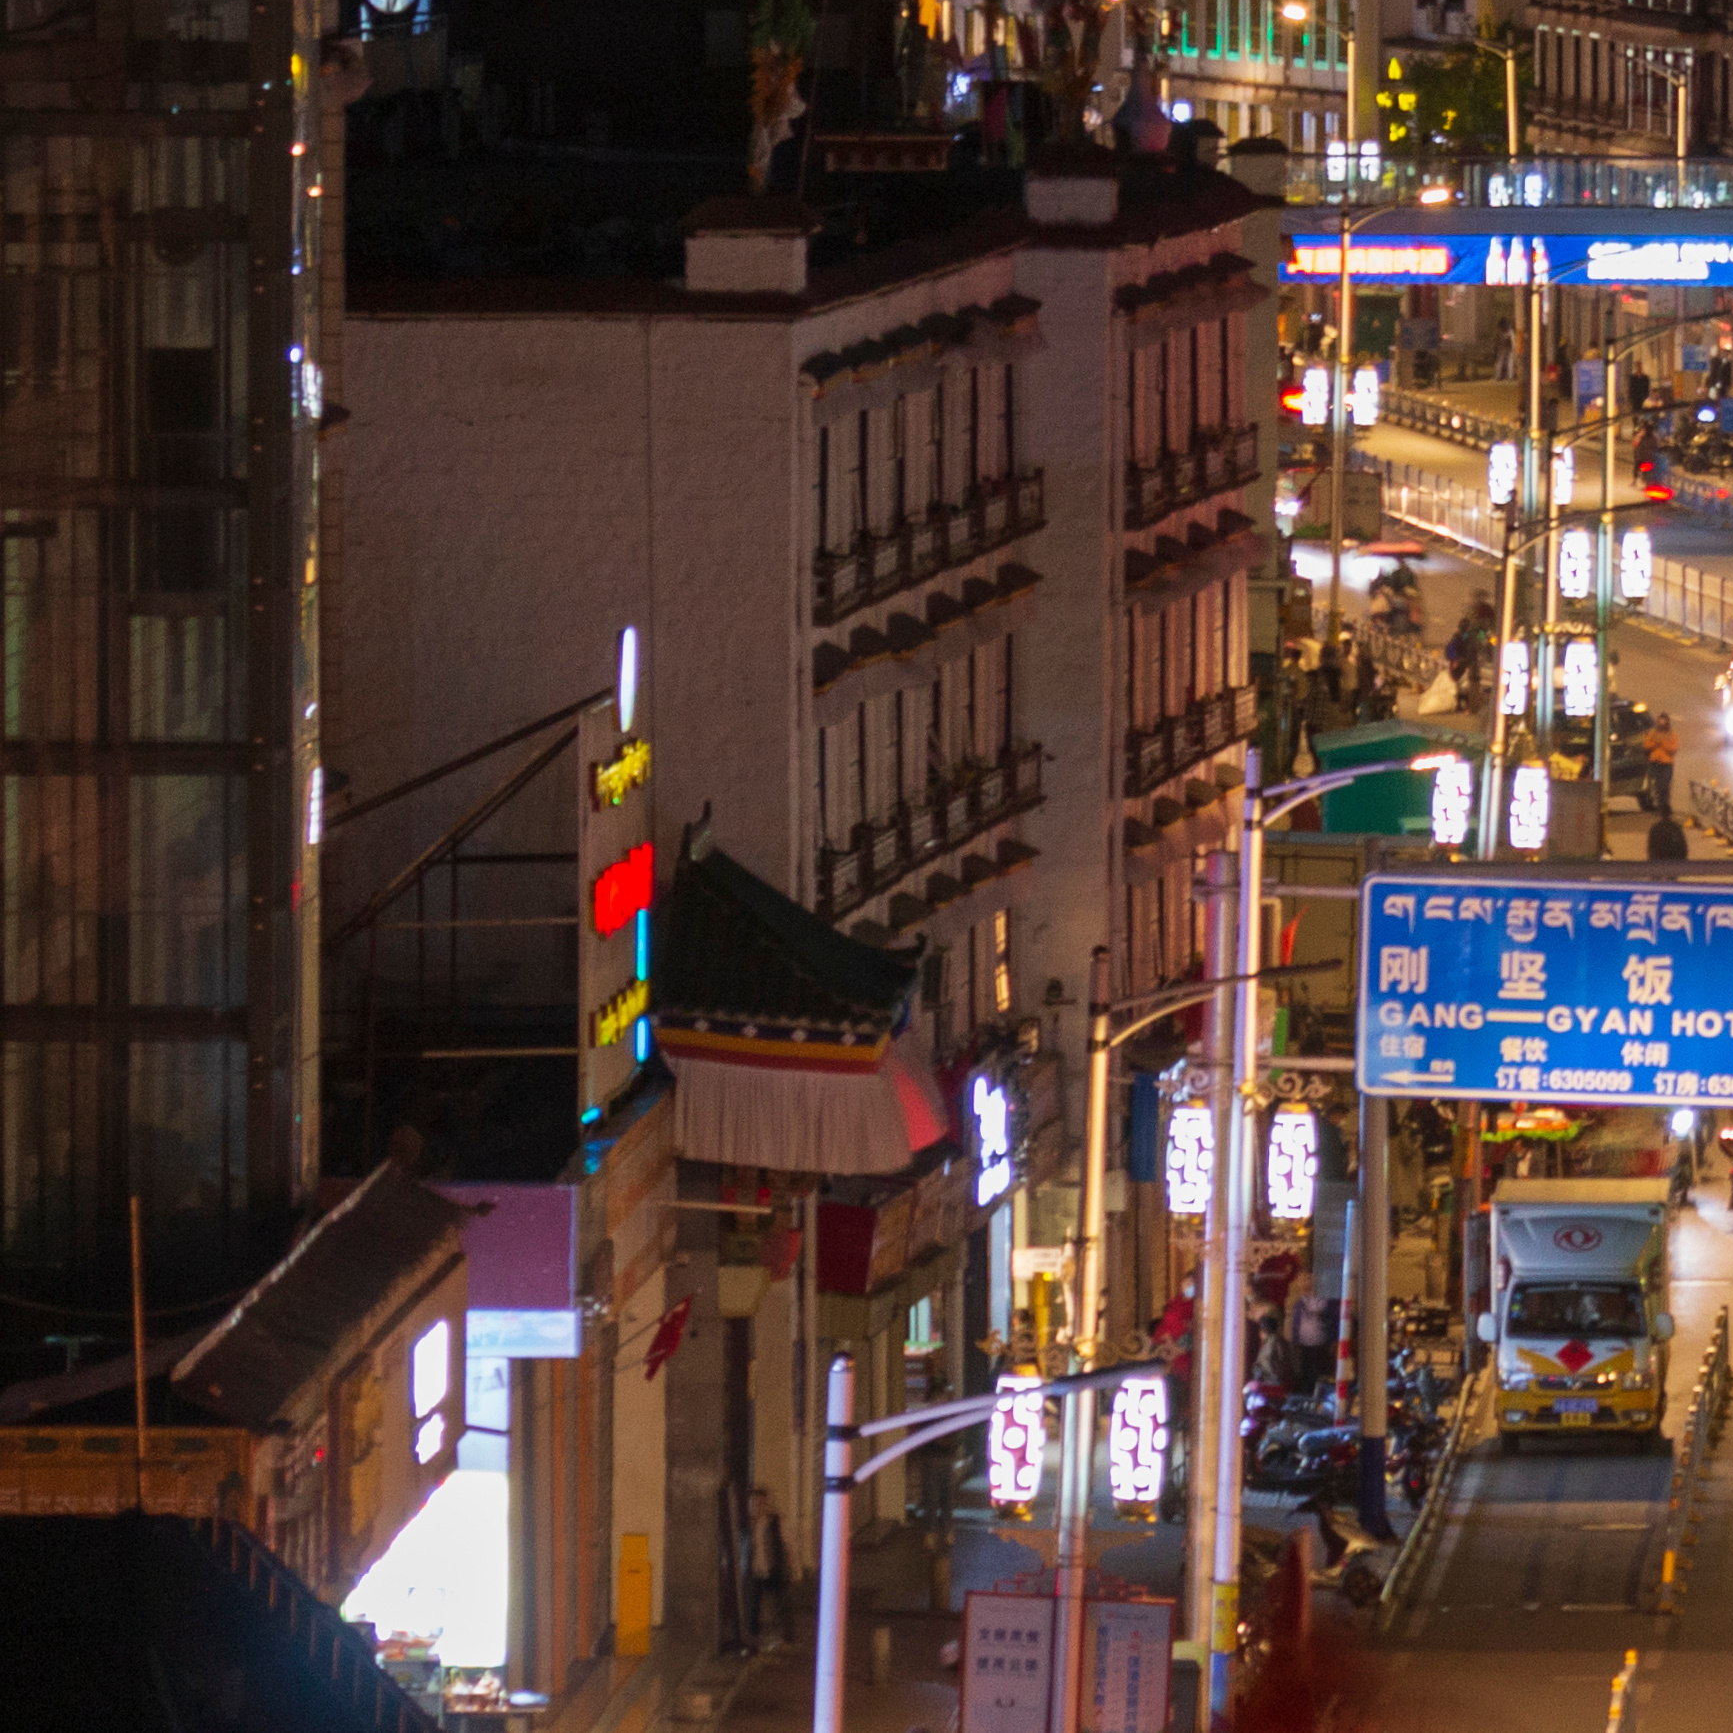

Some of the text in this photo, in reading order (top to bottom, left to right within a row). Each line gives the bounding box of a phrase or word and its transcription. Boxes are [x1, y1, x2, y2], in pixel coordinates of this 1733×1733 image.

[1379, 1034, 1427, 1059] 住宿
[1499, 1035, 1549, 1063] 餐饮
[1621, 1040, 1670, 1068] 休闲
